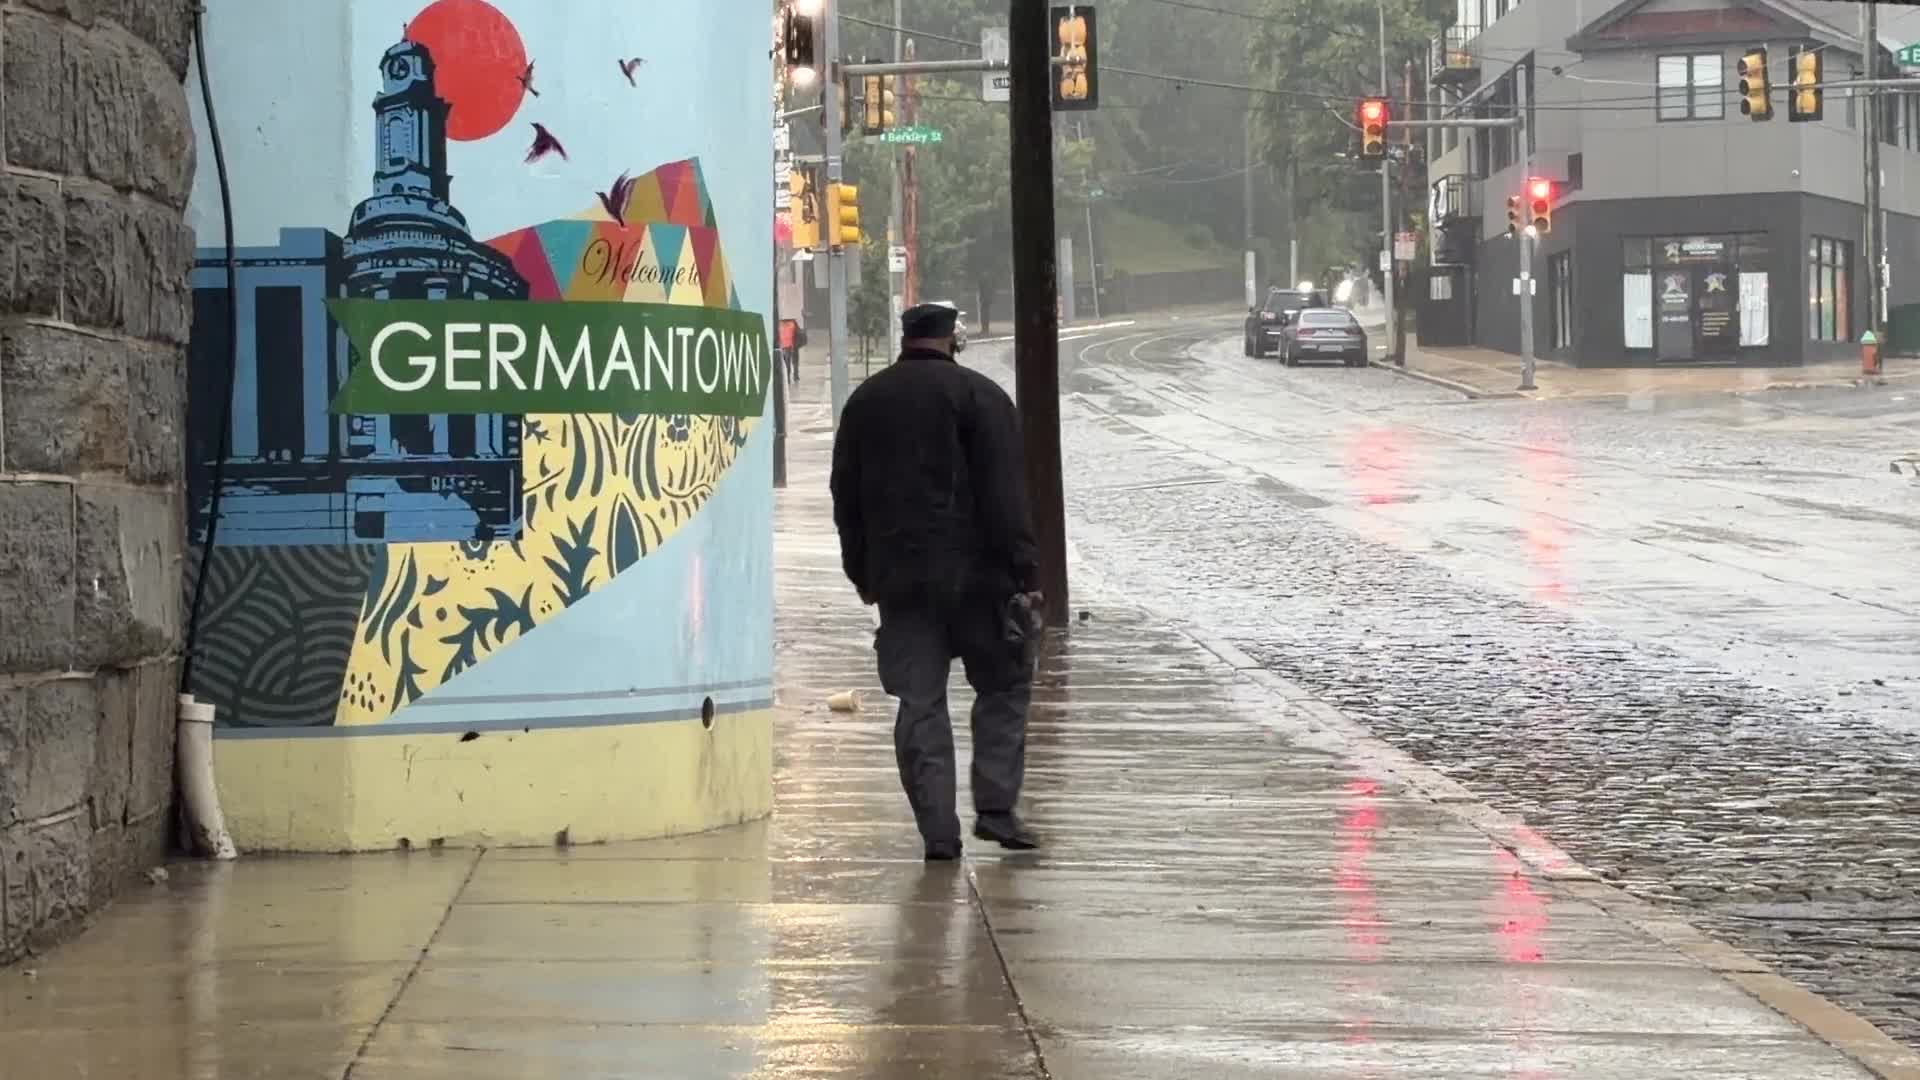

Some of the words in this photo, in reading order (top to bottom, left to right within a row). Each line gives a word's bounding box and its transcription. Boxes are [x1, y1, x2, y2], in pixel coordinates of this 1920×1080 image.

[888, 131, 928, 144] Berkley
[931, 130, 943, 142] St
[583, 237, 686, 286] Welcome
[369, 321, 761, 396] GERMANTOWN
